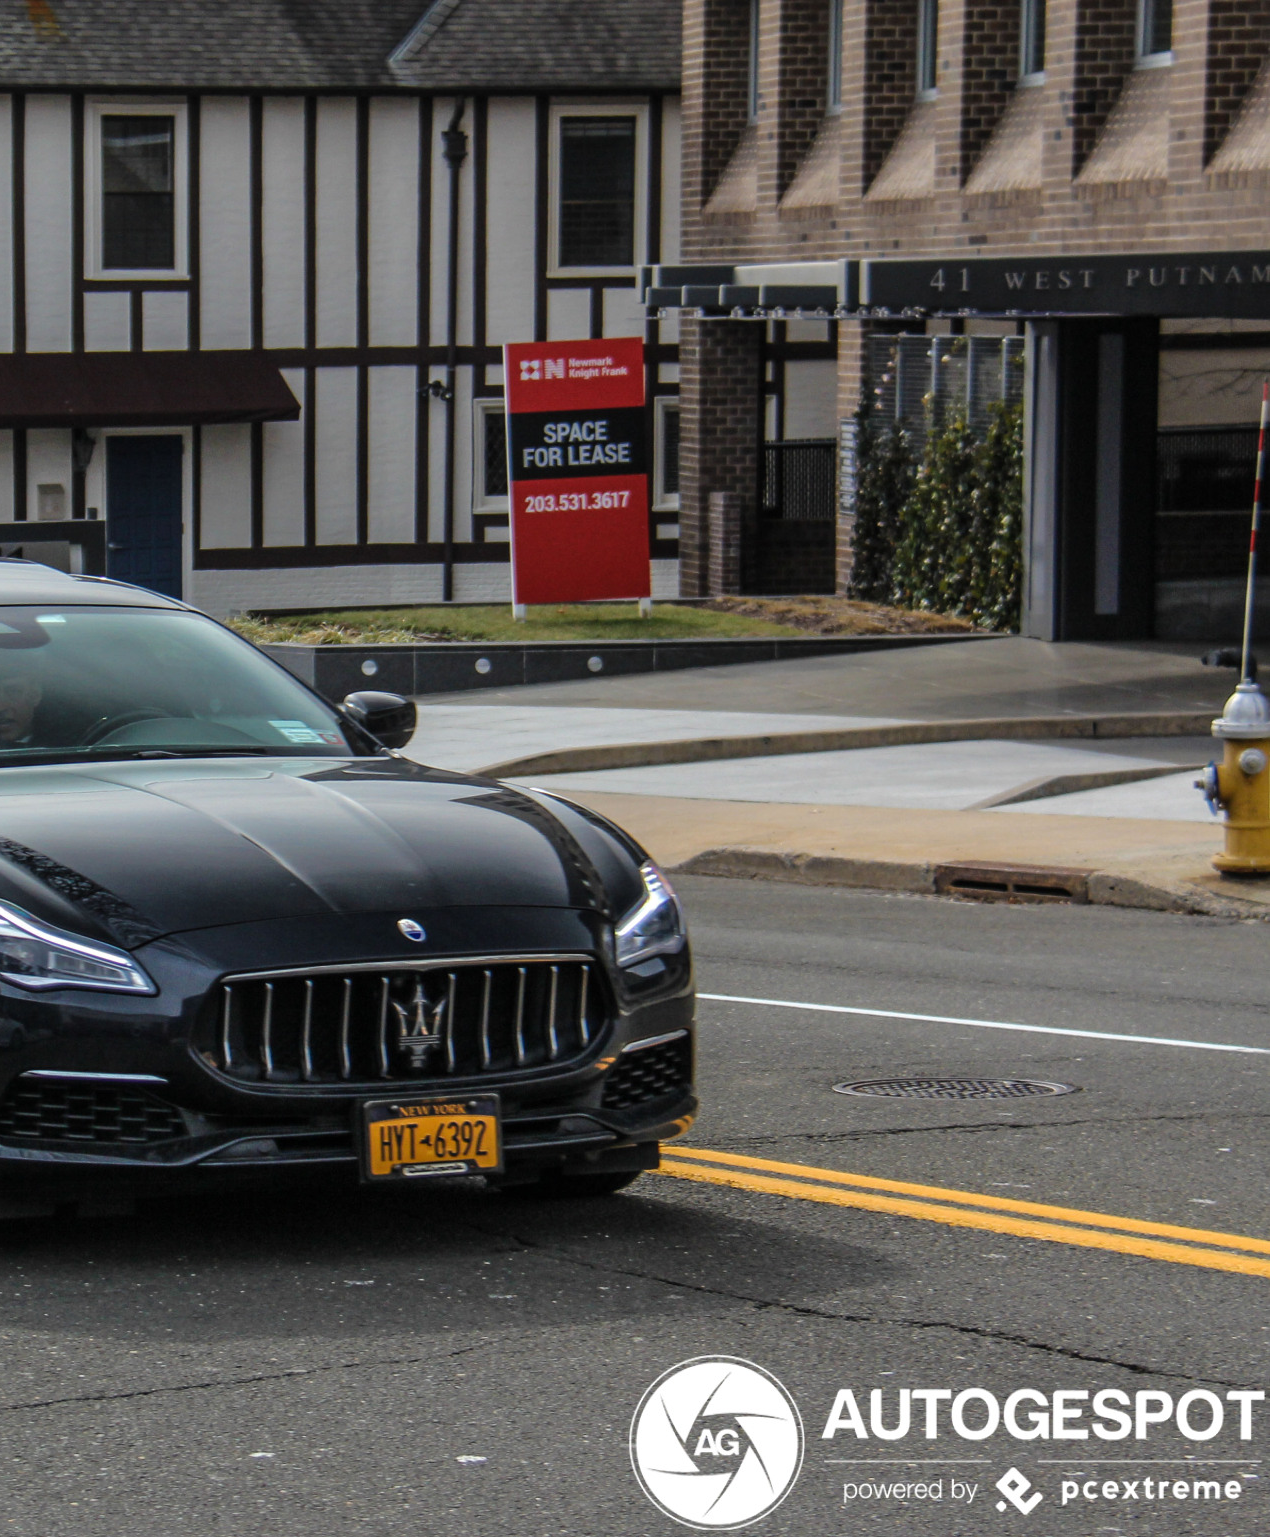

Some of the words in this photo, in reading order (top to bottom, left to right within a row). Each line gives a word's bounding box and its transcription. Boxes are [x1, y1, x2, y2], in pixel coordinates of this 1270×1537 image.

[930, 267, 970, 292] 41
[1004, 269, 1094, 290] WEST
[1125, 265, 1270, 287] PUTNAM
[568, 357, 612, 368] Newmark
[568, 368, 598, 380] Knight
[601, 366, 628, 377] Frank
[543, 420, 608, 444] SPACE
[523, 447, 562, 468] FOR
[568, 443, 630, 467] LEASE
[525, 491, 629, 513] 203.531.3617
[399, 1105, 429, 1117] NEW
[433, 1103, 468, 1115] YORK
